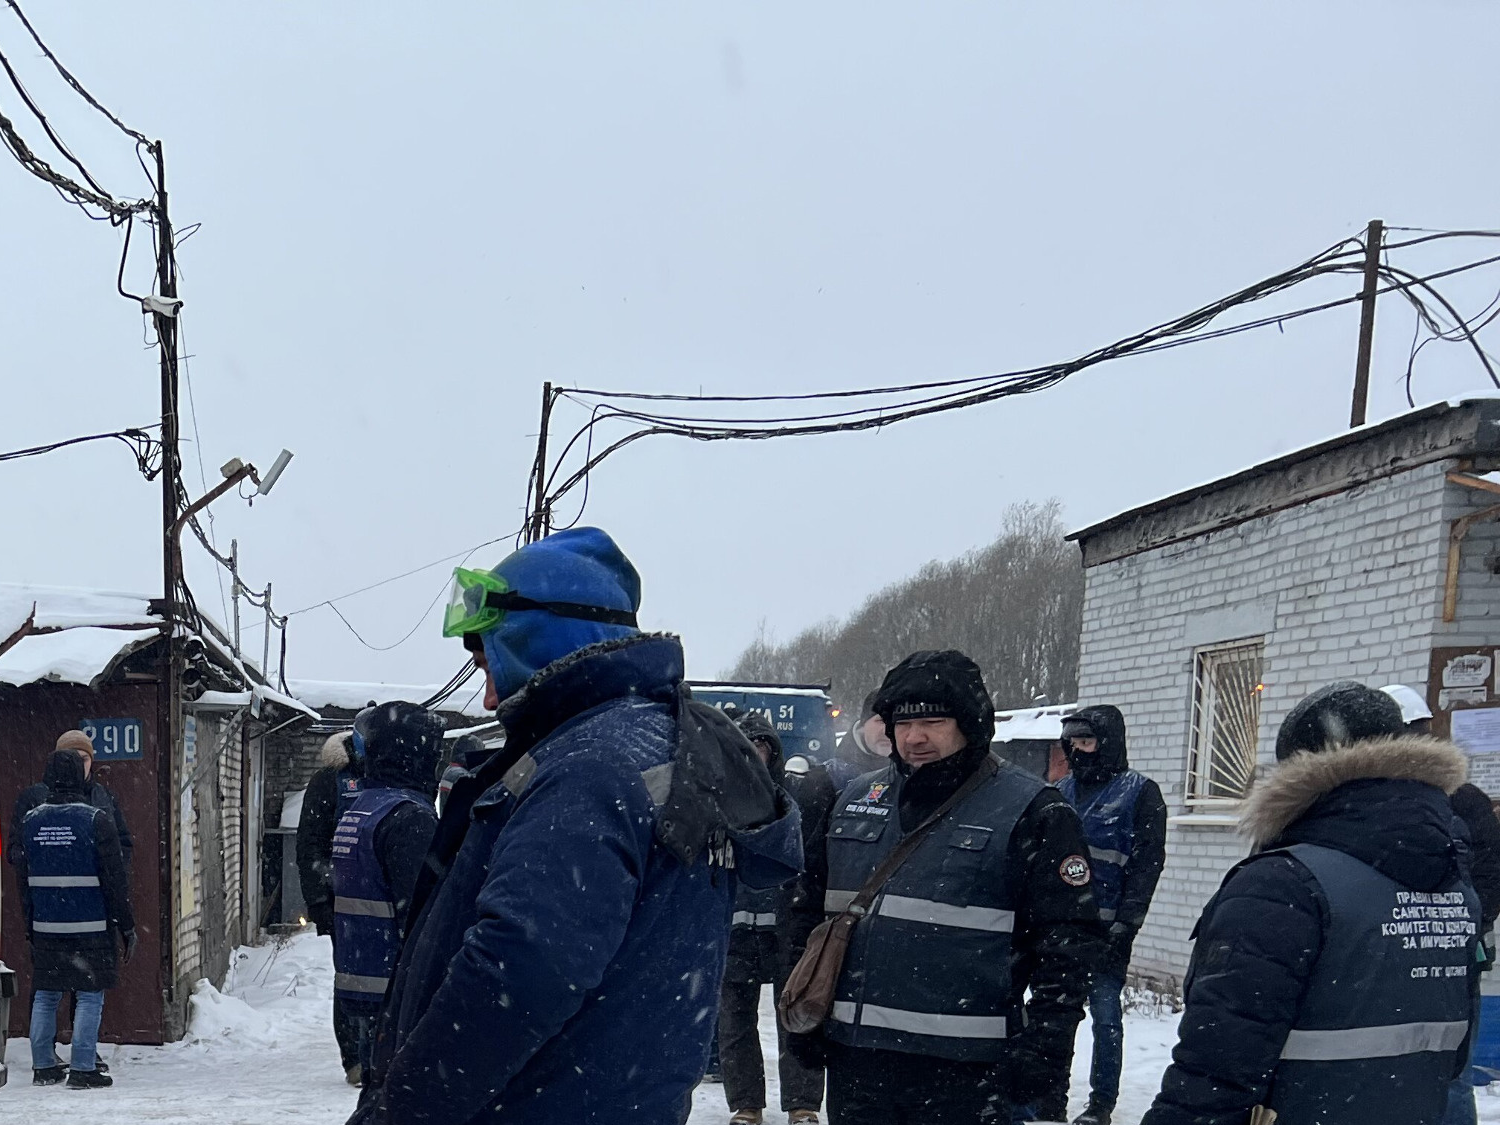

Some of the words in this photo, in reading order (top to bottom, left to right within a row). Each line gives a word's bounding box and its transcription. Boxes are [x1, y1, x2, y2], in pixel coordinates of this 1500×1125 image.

[778, 705, 795, 719] 51
[776, 721, 794, 731] RUS
[1381, 921, 1430, 936] КОМИТЕТ
[1431, 921, 1444, 934] ПО
[1402, 936, 1417, 949] ЗА
